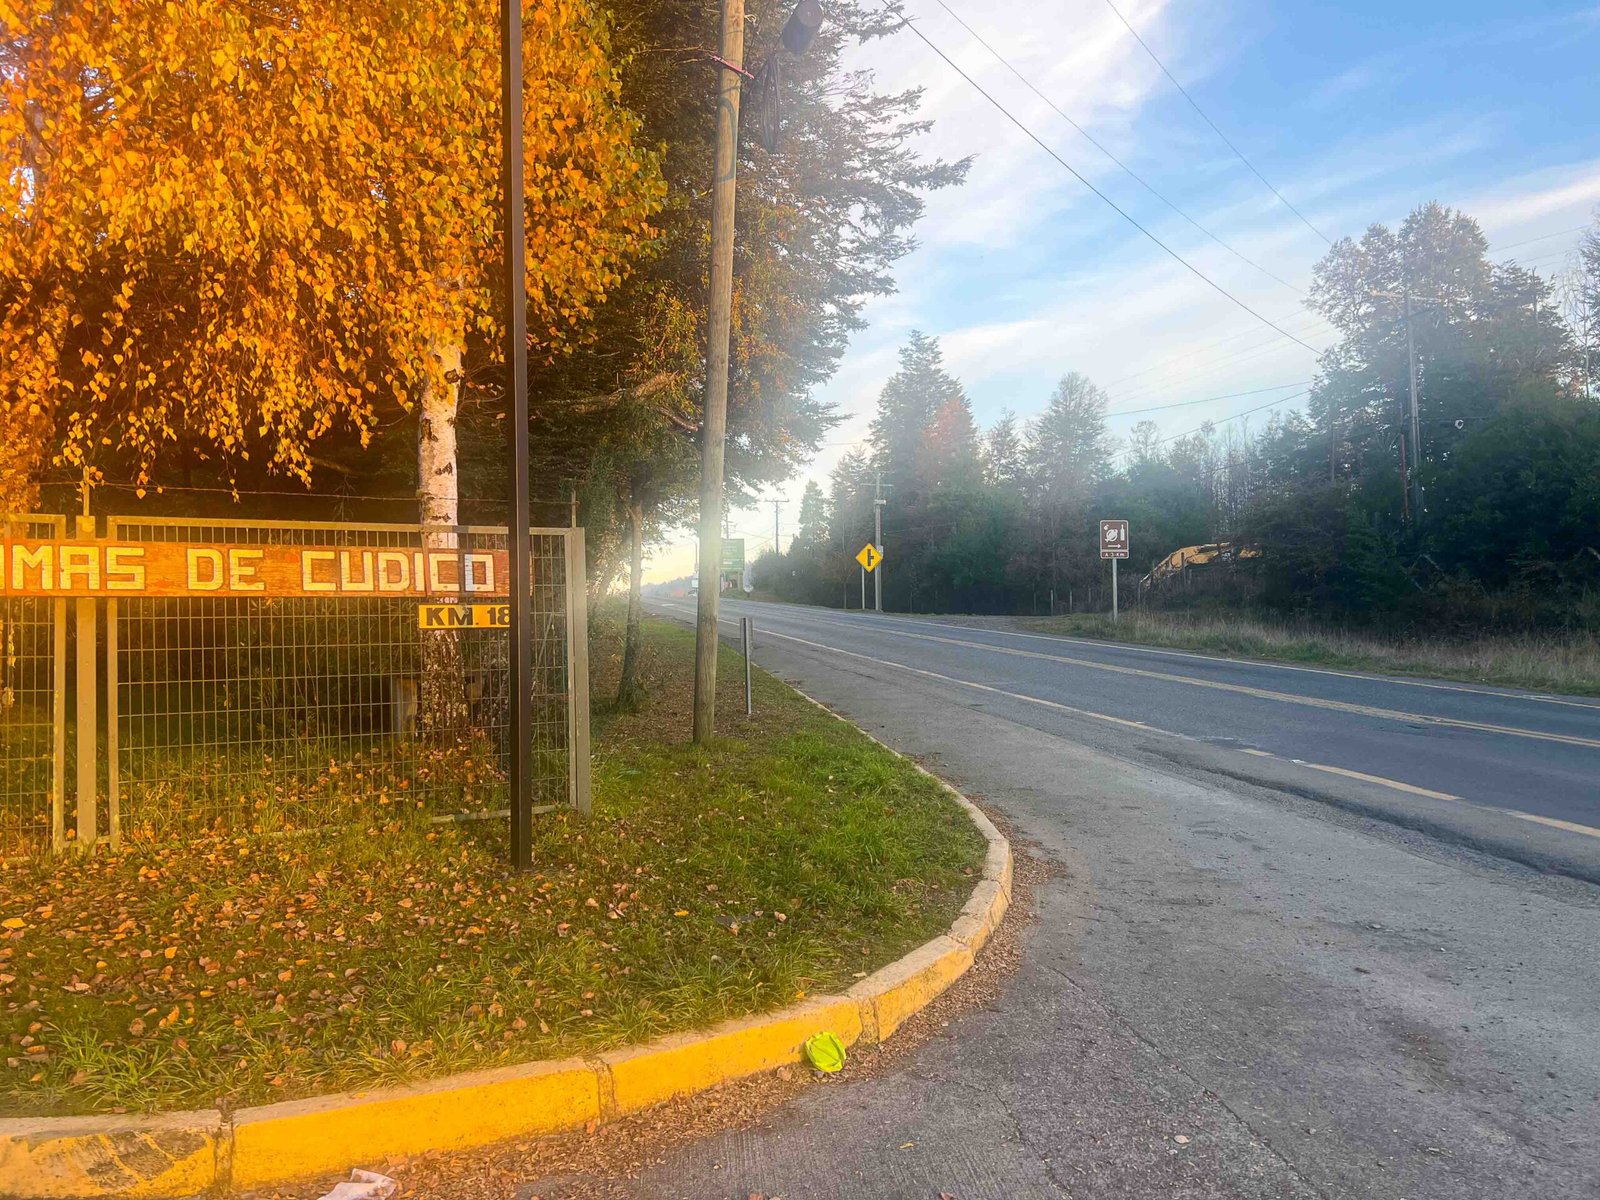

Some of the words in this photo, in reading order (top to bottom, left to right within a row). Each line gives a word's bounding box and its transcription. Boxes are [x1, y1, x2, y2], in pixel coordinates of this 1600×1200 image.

[0, 544, 145, 590] MAS
[187, 548, 265, 591] DE
[302, 550, 495, 592] CUDICO
[426, 607, 479, 626] KM.
